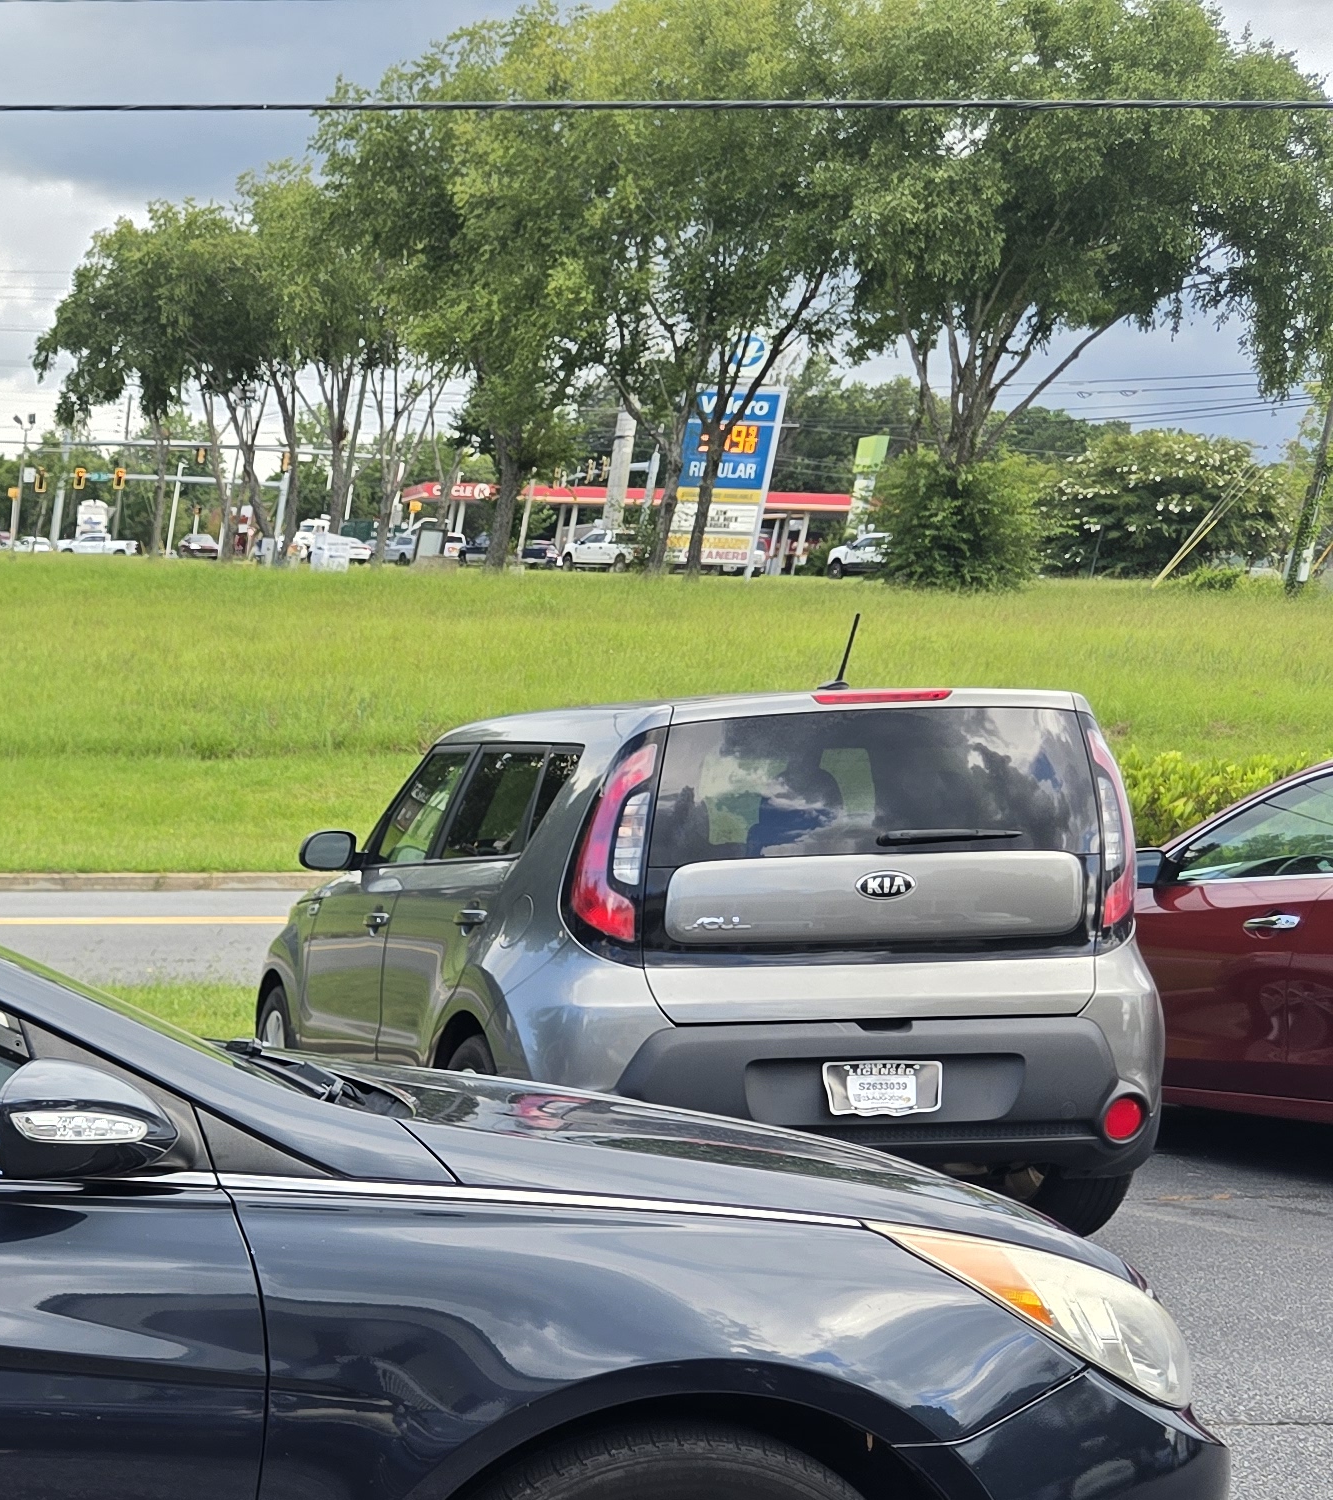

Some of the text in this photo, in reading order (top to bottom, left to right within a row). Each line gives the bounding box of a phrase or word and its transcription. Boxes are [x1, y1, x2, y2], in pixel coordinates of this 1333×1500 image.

[701, 395, 770, 416] Vlero
[689, 461, 757, 479] RULAR
[433, 484, 473, 496] CCLE
[684, 550, 748, 561] CEANERS
[867, 876, 906, 894] KIA
[849, 1067, 915, 1076] LICENSED
[858, 1082, 908, 1091] S2633039
